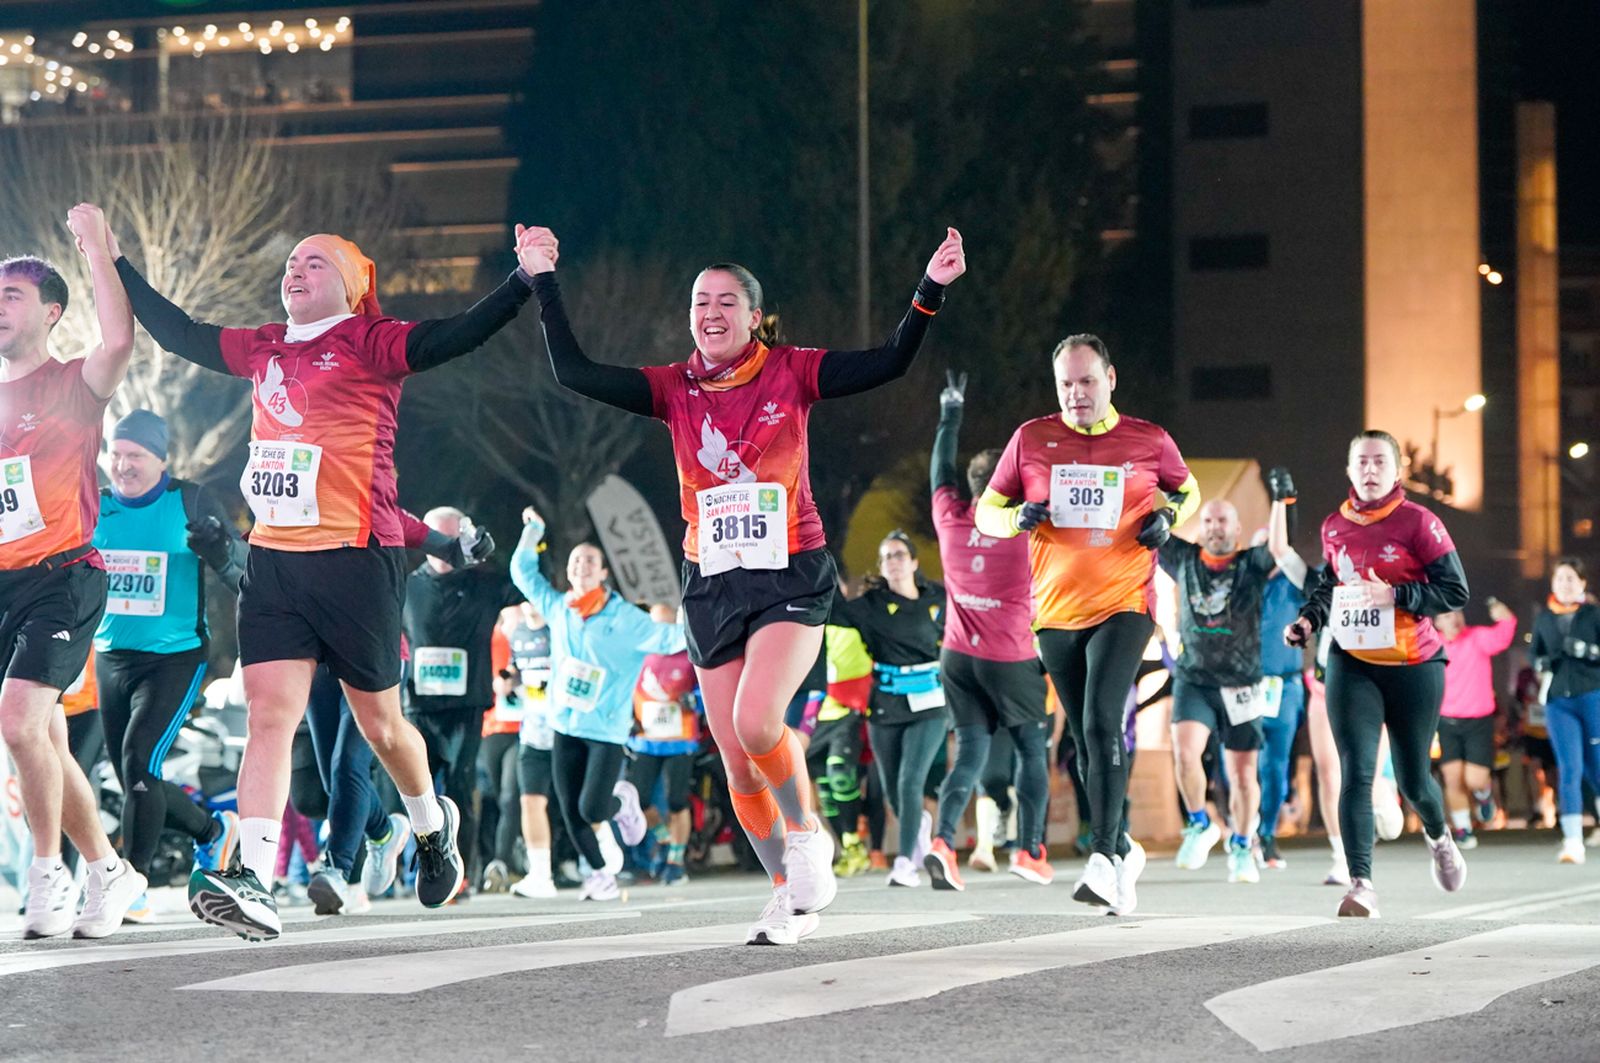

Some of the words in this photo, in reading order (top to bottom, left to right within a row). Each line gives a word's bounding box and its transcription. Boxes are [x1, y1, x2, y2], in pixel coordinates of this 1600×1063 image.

[268, 391, 287, 416] 43
[717, 457, 741, 479] 43
[251, 470, 299, 498] 3203
[713, 493, 737, 505] NOCHE
[739, 493, 750, 501] DE
[1069, 487, 1105, 507] 303
[706, 507, 720, 519] SAN
[712, 514, 768, 543] 3815
[106, 573, 155, 593] 12970
[1341, 608, 1381, 627] 3448
